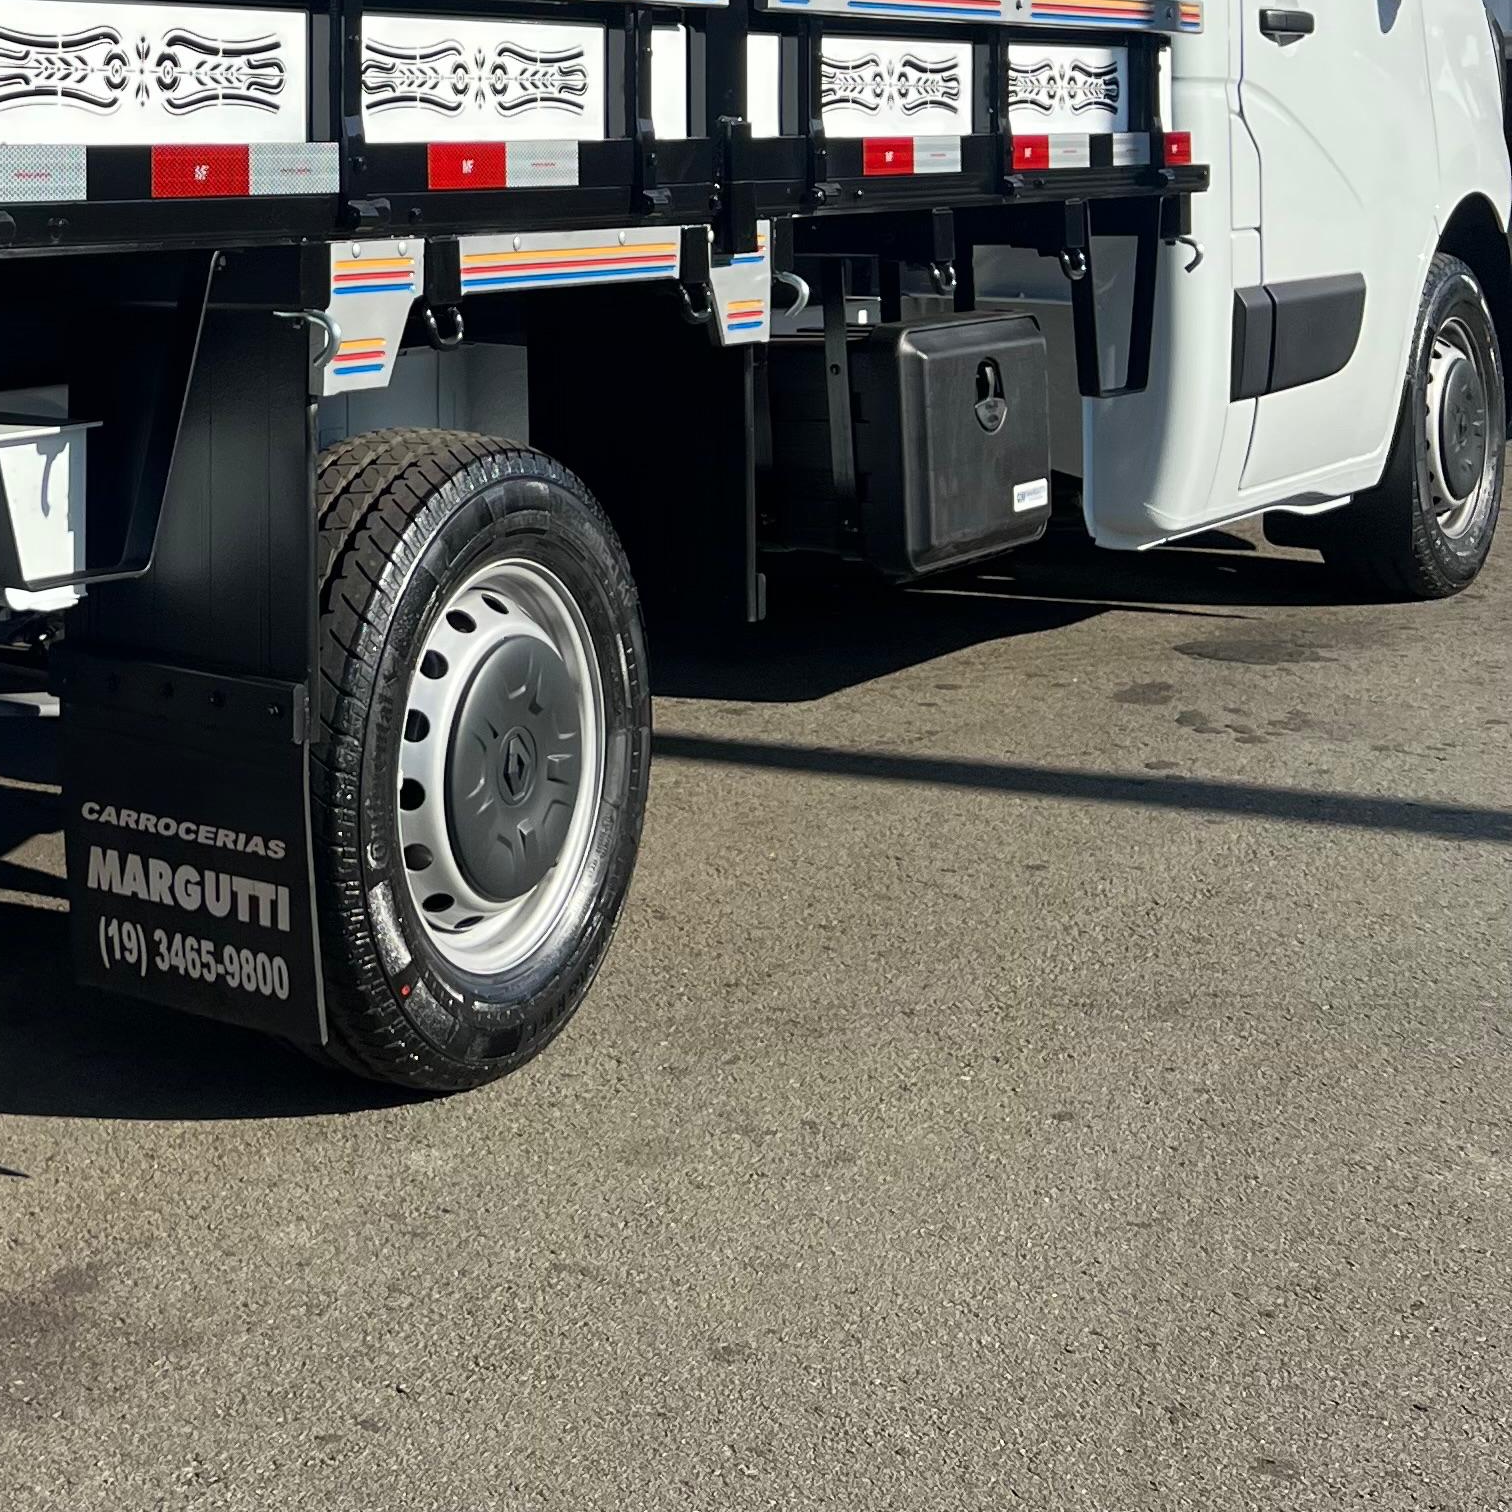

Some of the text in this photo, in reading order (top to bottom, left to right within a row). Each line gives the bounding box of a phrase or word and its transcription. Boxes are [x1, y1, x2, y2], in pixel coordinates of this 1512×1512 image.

[81, 801, 286, 860] CARROCERIAS
[86, 845, 291, 933] MARGUTTI
[98, 915, 290, 1001] (19) 3465-9800
